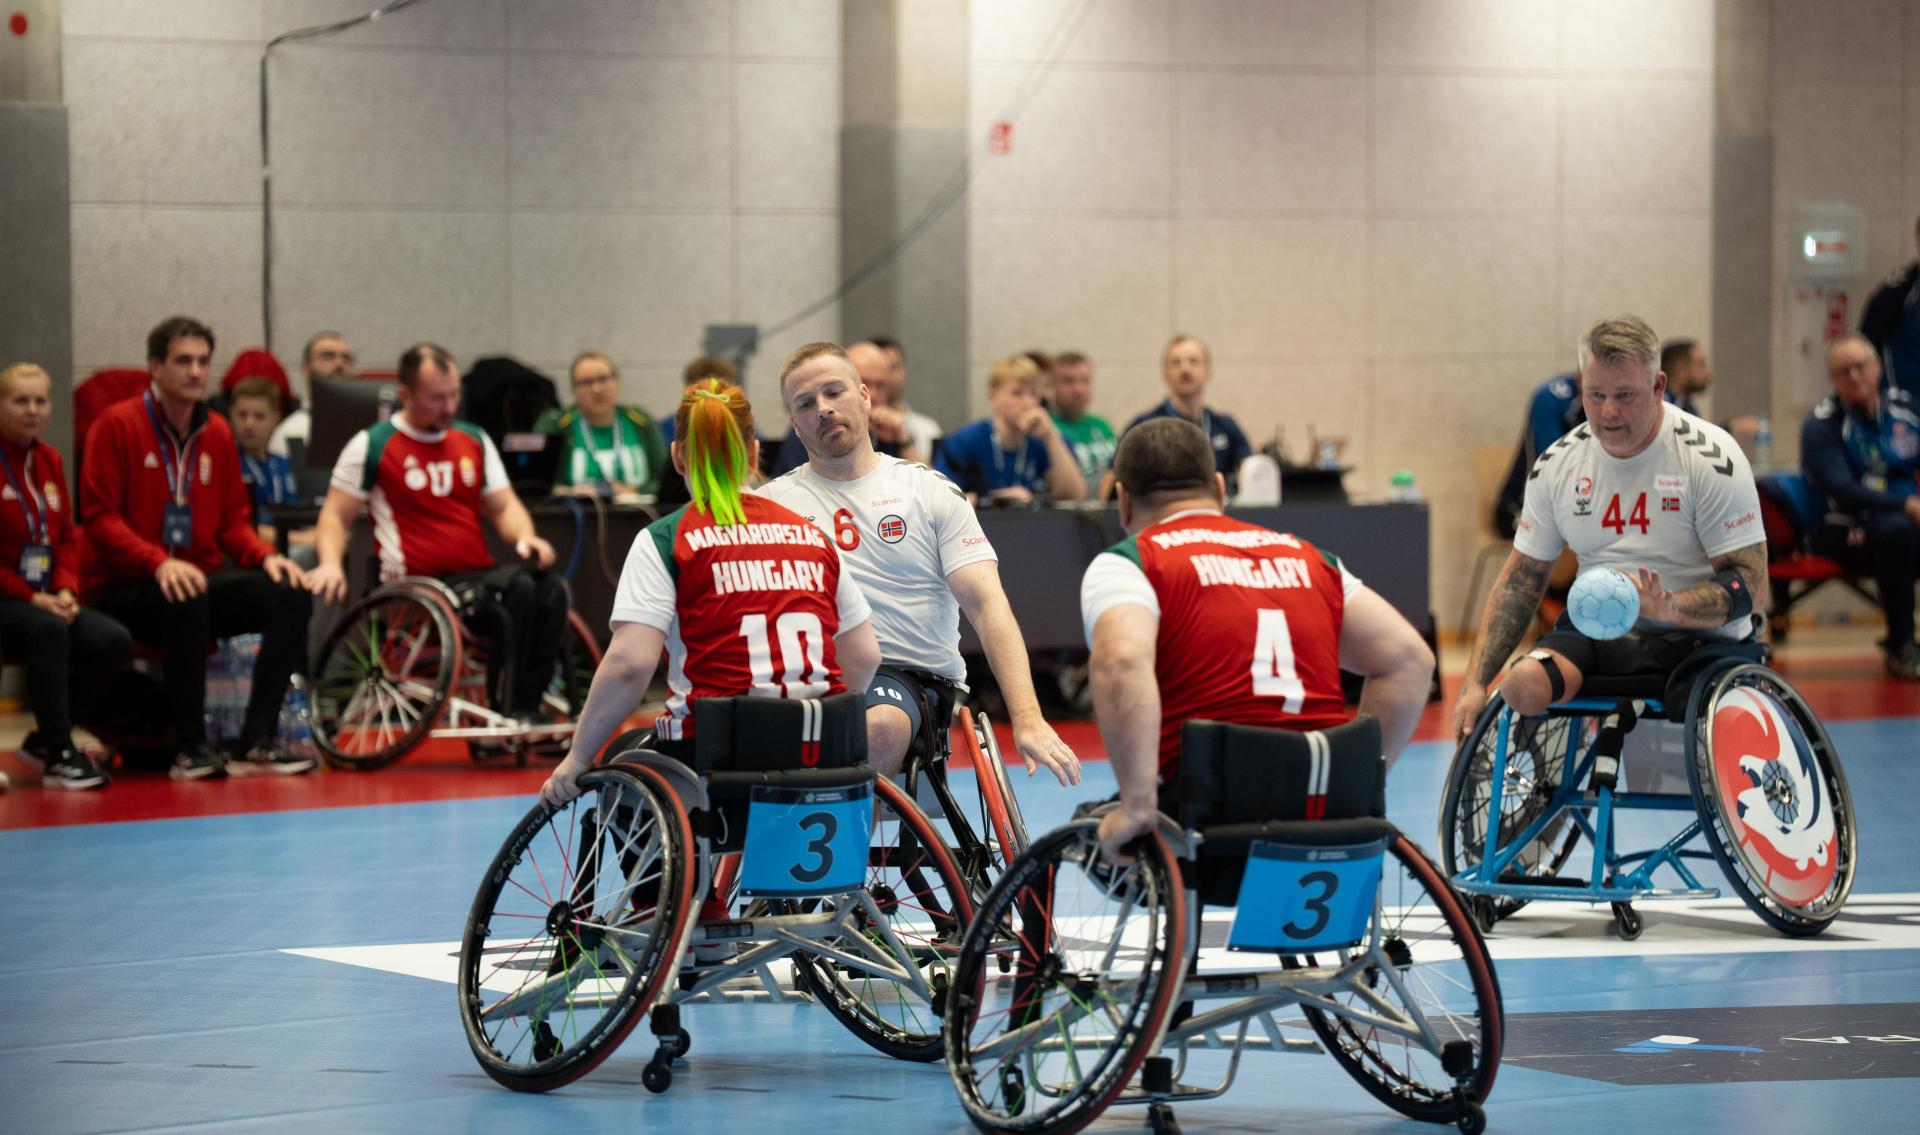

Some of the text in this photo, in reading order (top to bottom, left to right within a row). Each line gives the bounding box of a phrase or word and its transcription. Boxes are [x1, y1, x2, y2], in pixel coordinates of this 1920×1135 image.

[871, 496, 904, 508] Scandic
[1601, 491, 1650, 535] 44
[1723, 512, 1757, 529] Scandic
[834, 508, 861, 551] 6
[711, 560, 824, 595] HUNGARY
[1190, 554, 1312, 589] HUNGARY
[739, 612, 831, 699] 10
[1251, 608, 1306, 715] 4
[788, 811, 838, 883] 3
[1281, 870, 1339, 939] 3
